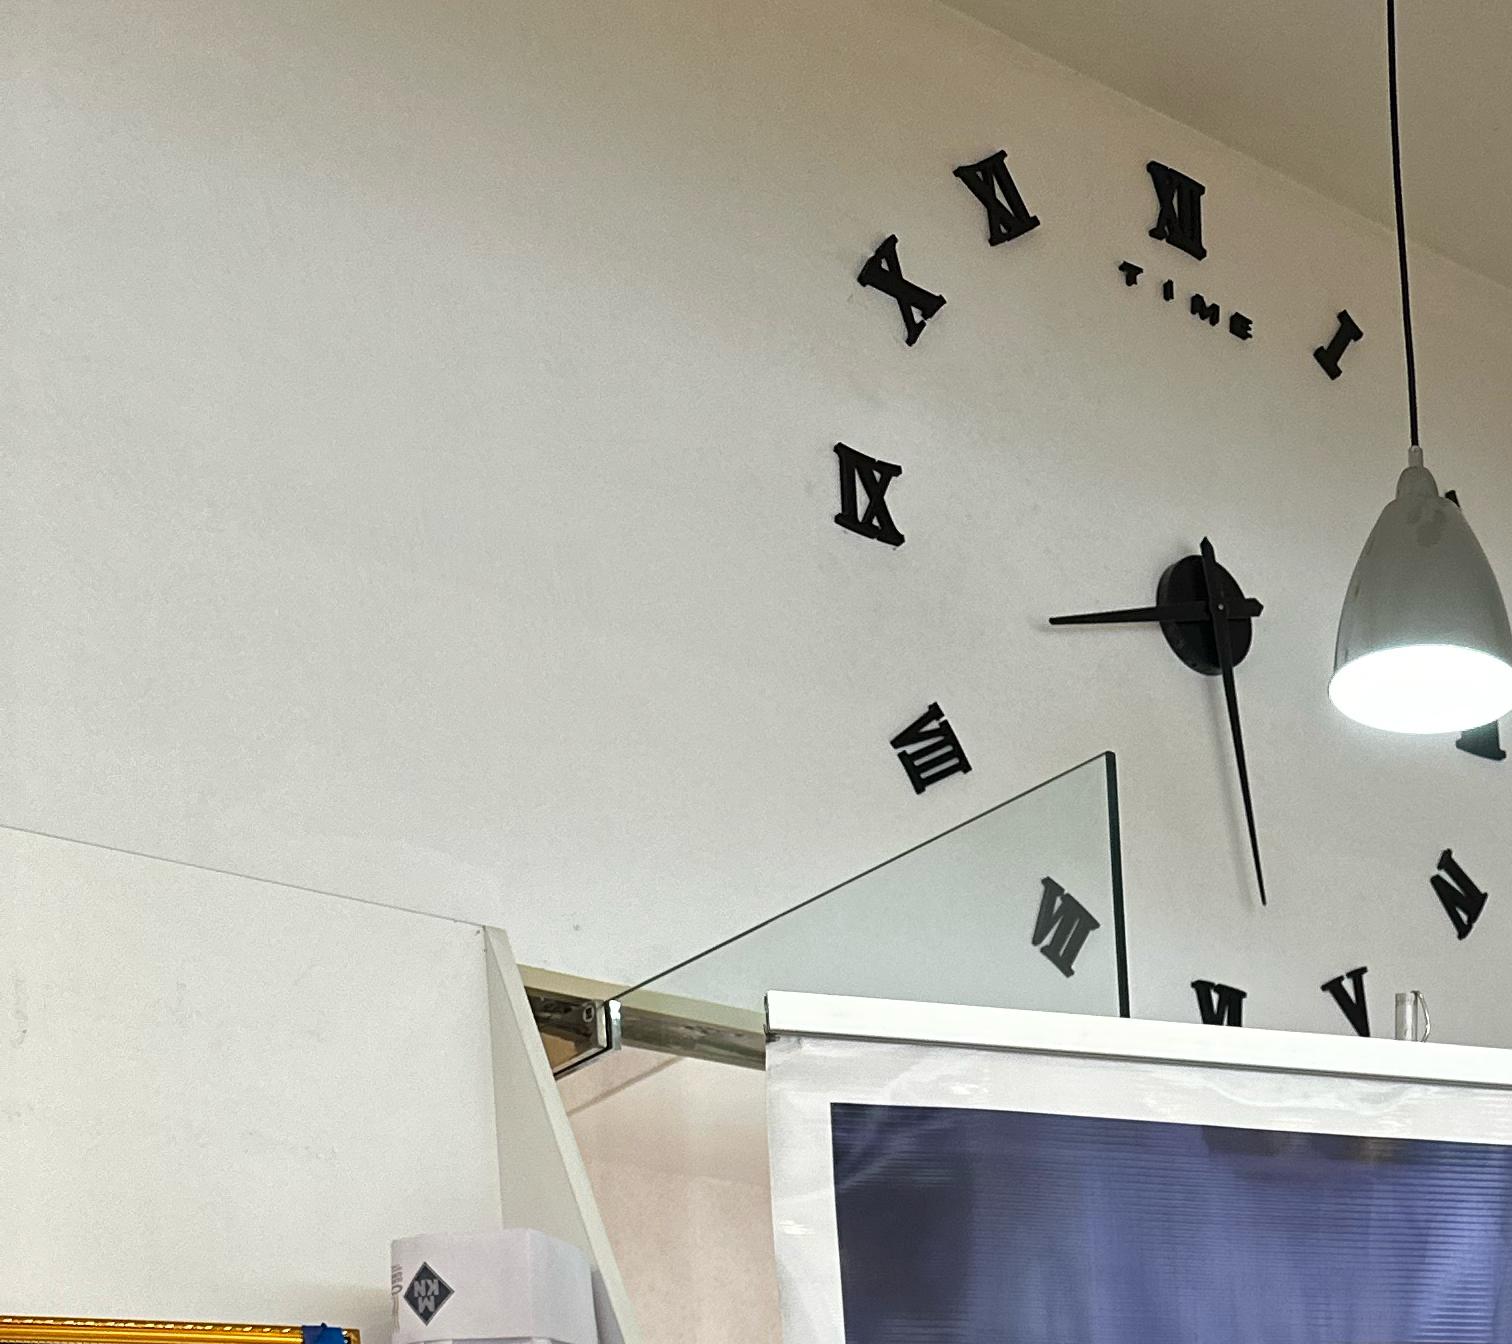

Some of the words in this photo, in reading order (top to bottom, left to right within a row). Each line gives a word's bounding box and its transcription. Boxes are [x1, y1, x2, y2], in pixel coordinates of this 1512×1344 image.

[856, 234, 947, 346] X
[1118, 259, 1254, 341] TIME
[833, 442, 905, 547] IX
